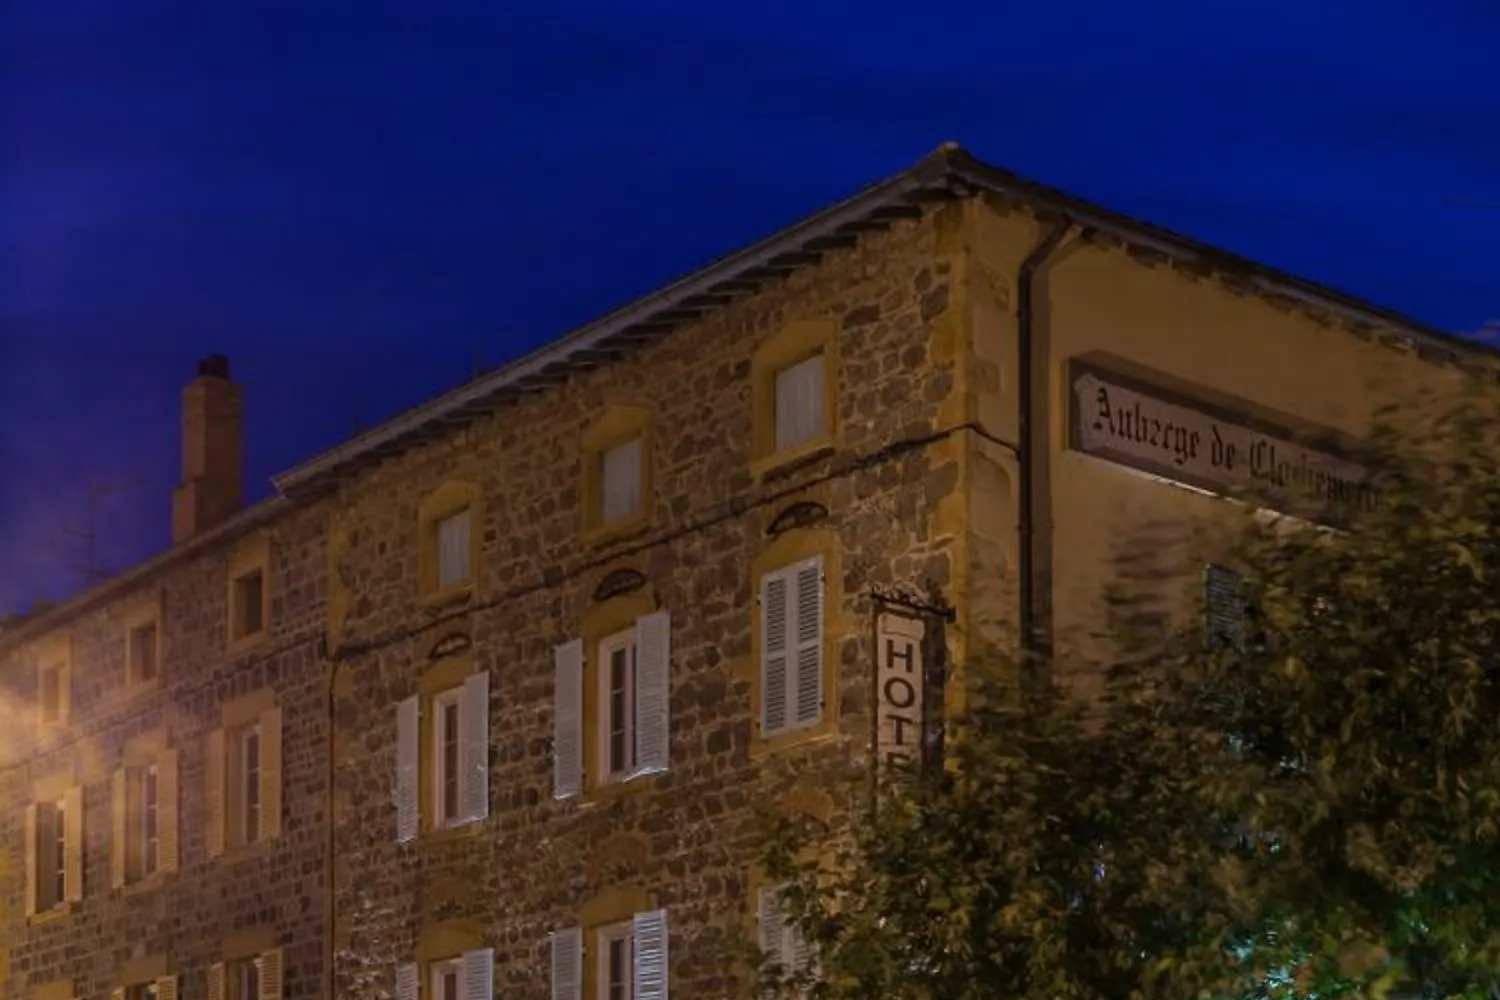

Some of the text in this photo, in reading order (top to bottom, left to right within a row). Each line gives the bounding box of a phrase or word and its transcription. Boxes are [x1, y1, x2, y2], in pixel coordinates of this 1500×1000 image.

[1092, 387, 1381, 513] Auberge de Clocheme
[884, 639, 916, 774] HOTE
